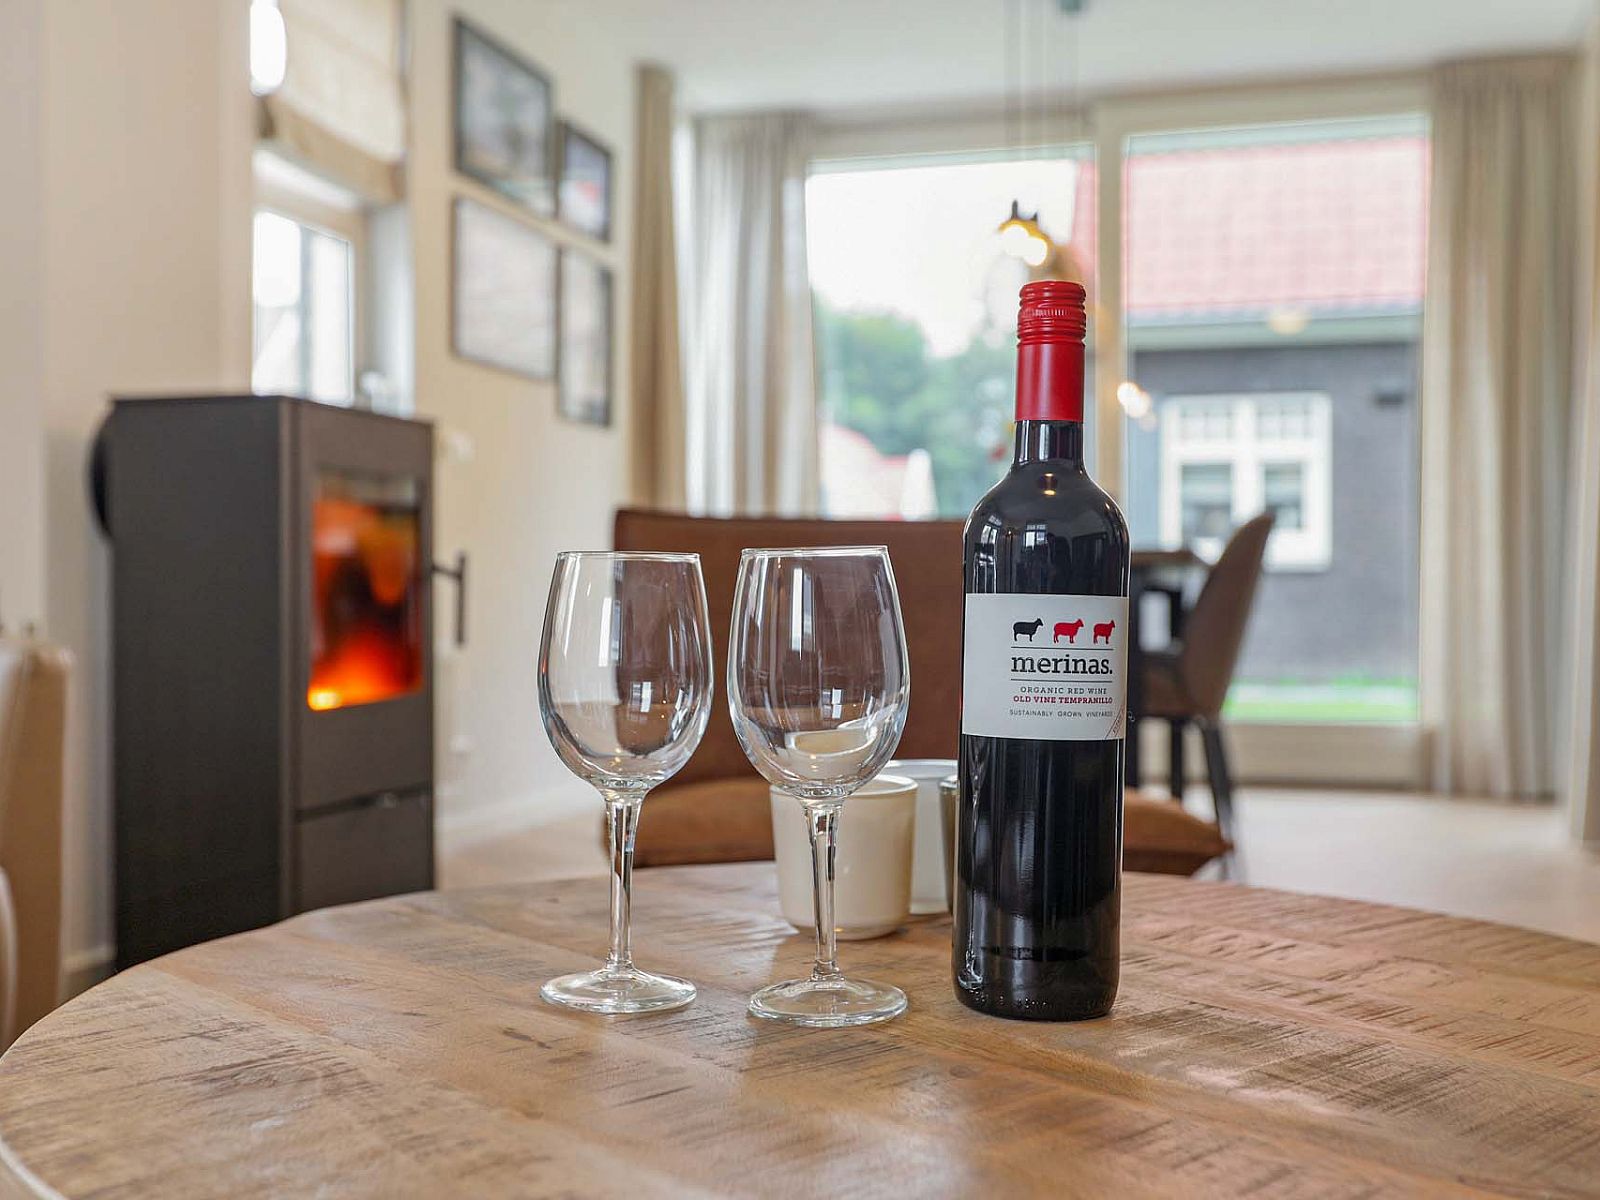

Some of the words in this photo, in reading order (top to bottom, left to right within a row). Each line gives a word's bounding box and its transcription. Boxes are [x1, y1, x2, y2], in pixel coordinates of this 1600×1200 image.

[1020, 686, 1064, 694] ORGANIC
[1067, 687, 1085, 695] RED
[1013, 695, 1031, 703] OLD
[1033, 696, 1056, 704] VINE
[1009, 709, 1053, 717] SUSTAINABLY
